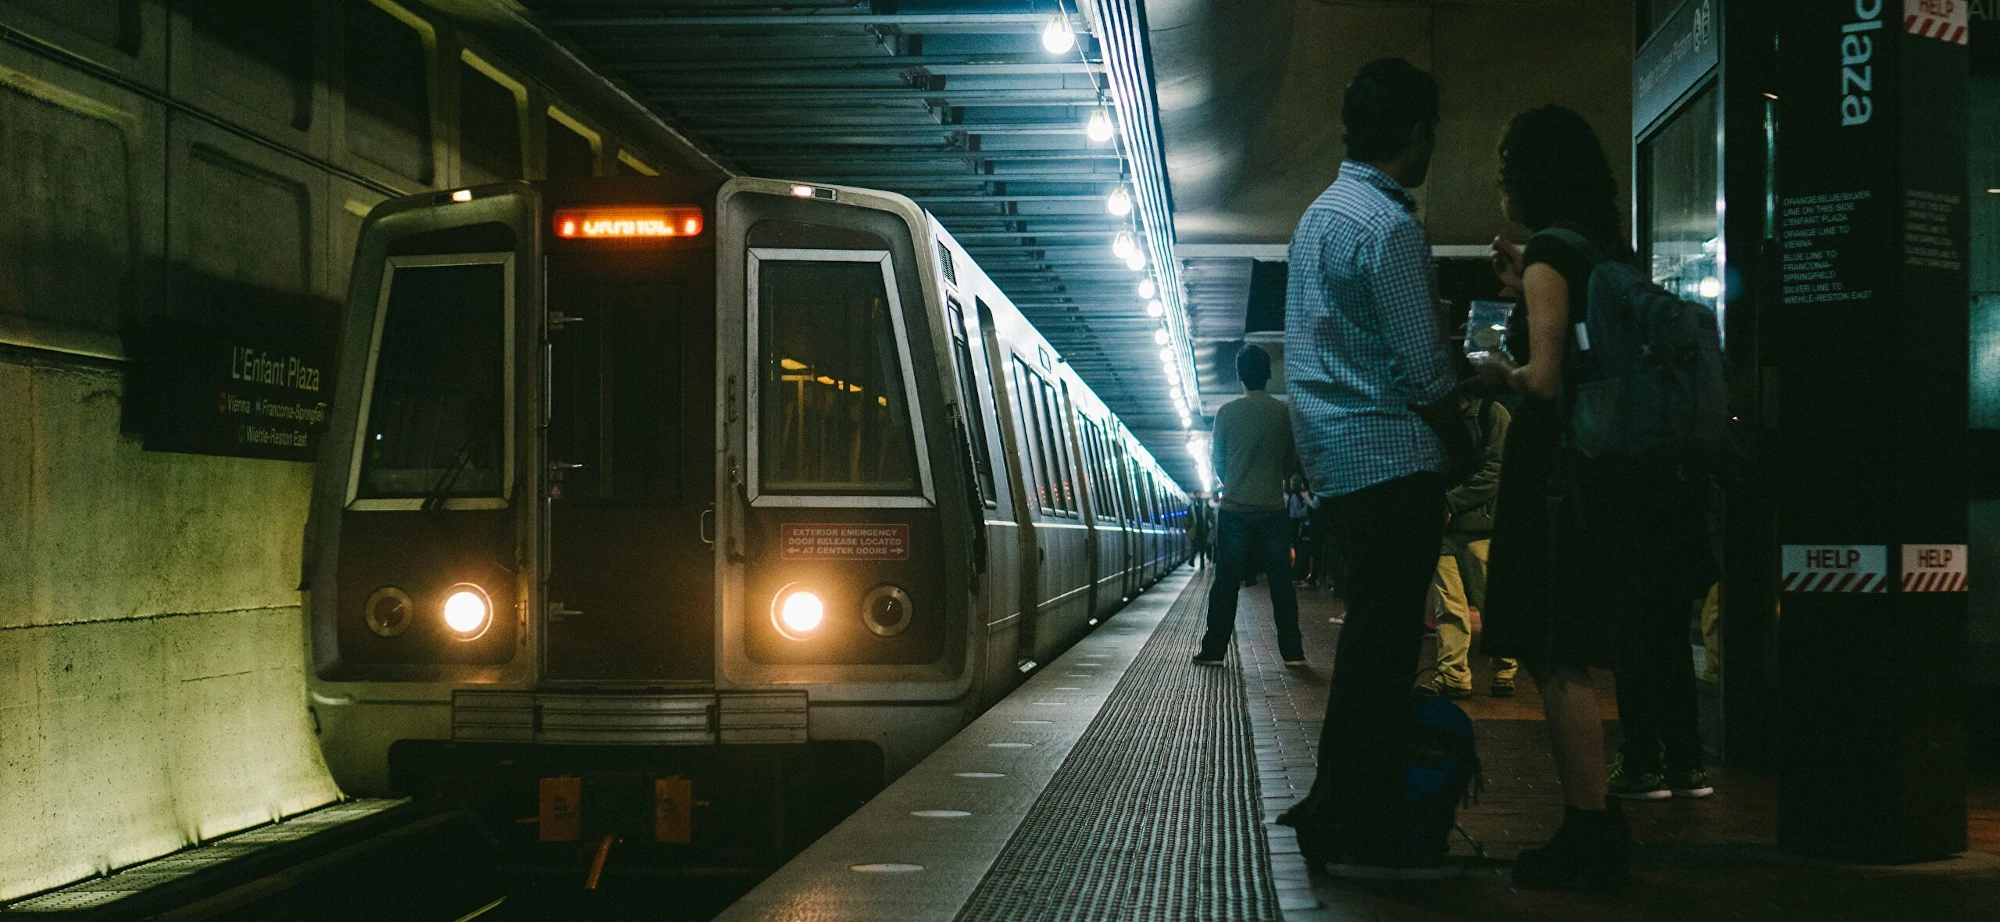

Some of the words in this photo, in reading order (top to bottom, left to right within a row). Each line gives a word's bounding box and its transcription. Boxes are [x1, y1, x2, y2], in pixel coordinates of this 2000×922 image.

[1783, 190, 1871, 206] ORANGE/BLUE/SILVER
[1783, 207, 1801, 217] LINE
[1802, 207, 1814, 215] ON
[1816, 204, 1834, 213] THIS
[1836, 202, 1855, 211] SIDE
[1783, 215, 1819, 227] L'ENFANT
[1821, 213, 1848, 223] PLAZA
[1783, 228, 1817, 239] ORANGE
[1818, 226, 1837, 236] LINE
[1838, 225, 1850, 235] TO
[1783, 240, 1813, 249] VIENNA
[1783, 252, 1804, 262] BLUE
[1806, 251, 1824, 260] LINE
[1825, 249, 1837, 258] TO
[1783, 271, 1835, 282] SPRINGFIELD
[1783, 284, 1810, 294] SILVER
[1812, 283, 1830, 292] LINE
[1831, 281, 1843, 291] TO
[1783, 292, 1849, 304] WIEHLE-RESTON
[1851, 290, 1872, 300] EAST
[232, 346, 285, 387] L'Enfant
[287, 355, 320, 392] Plaza
[227, 394, 250, 414] Vienna
[246, 425, 293, 446] Wiehle-Reston
[293, 430, 308, 447] East
[792, 528, 838, 537] EXTERIOR
[841, 528, 898, 537] EMERGENCY
[788, 537, 815, 545] DOOR
[817, 537, 857, 546] RELEASE
[860, 537, 902, 546] LOCATED
[856, 547, 888, 555] DOORS
[1806, 549, 1860, 569] HELP
[1919, 549, 1953, 568] HELP
